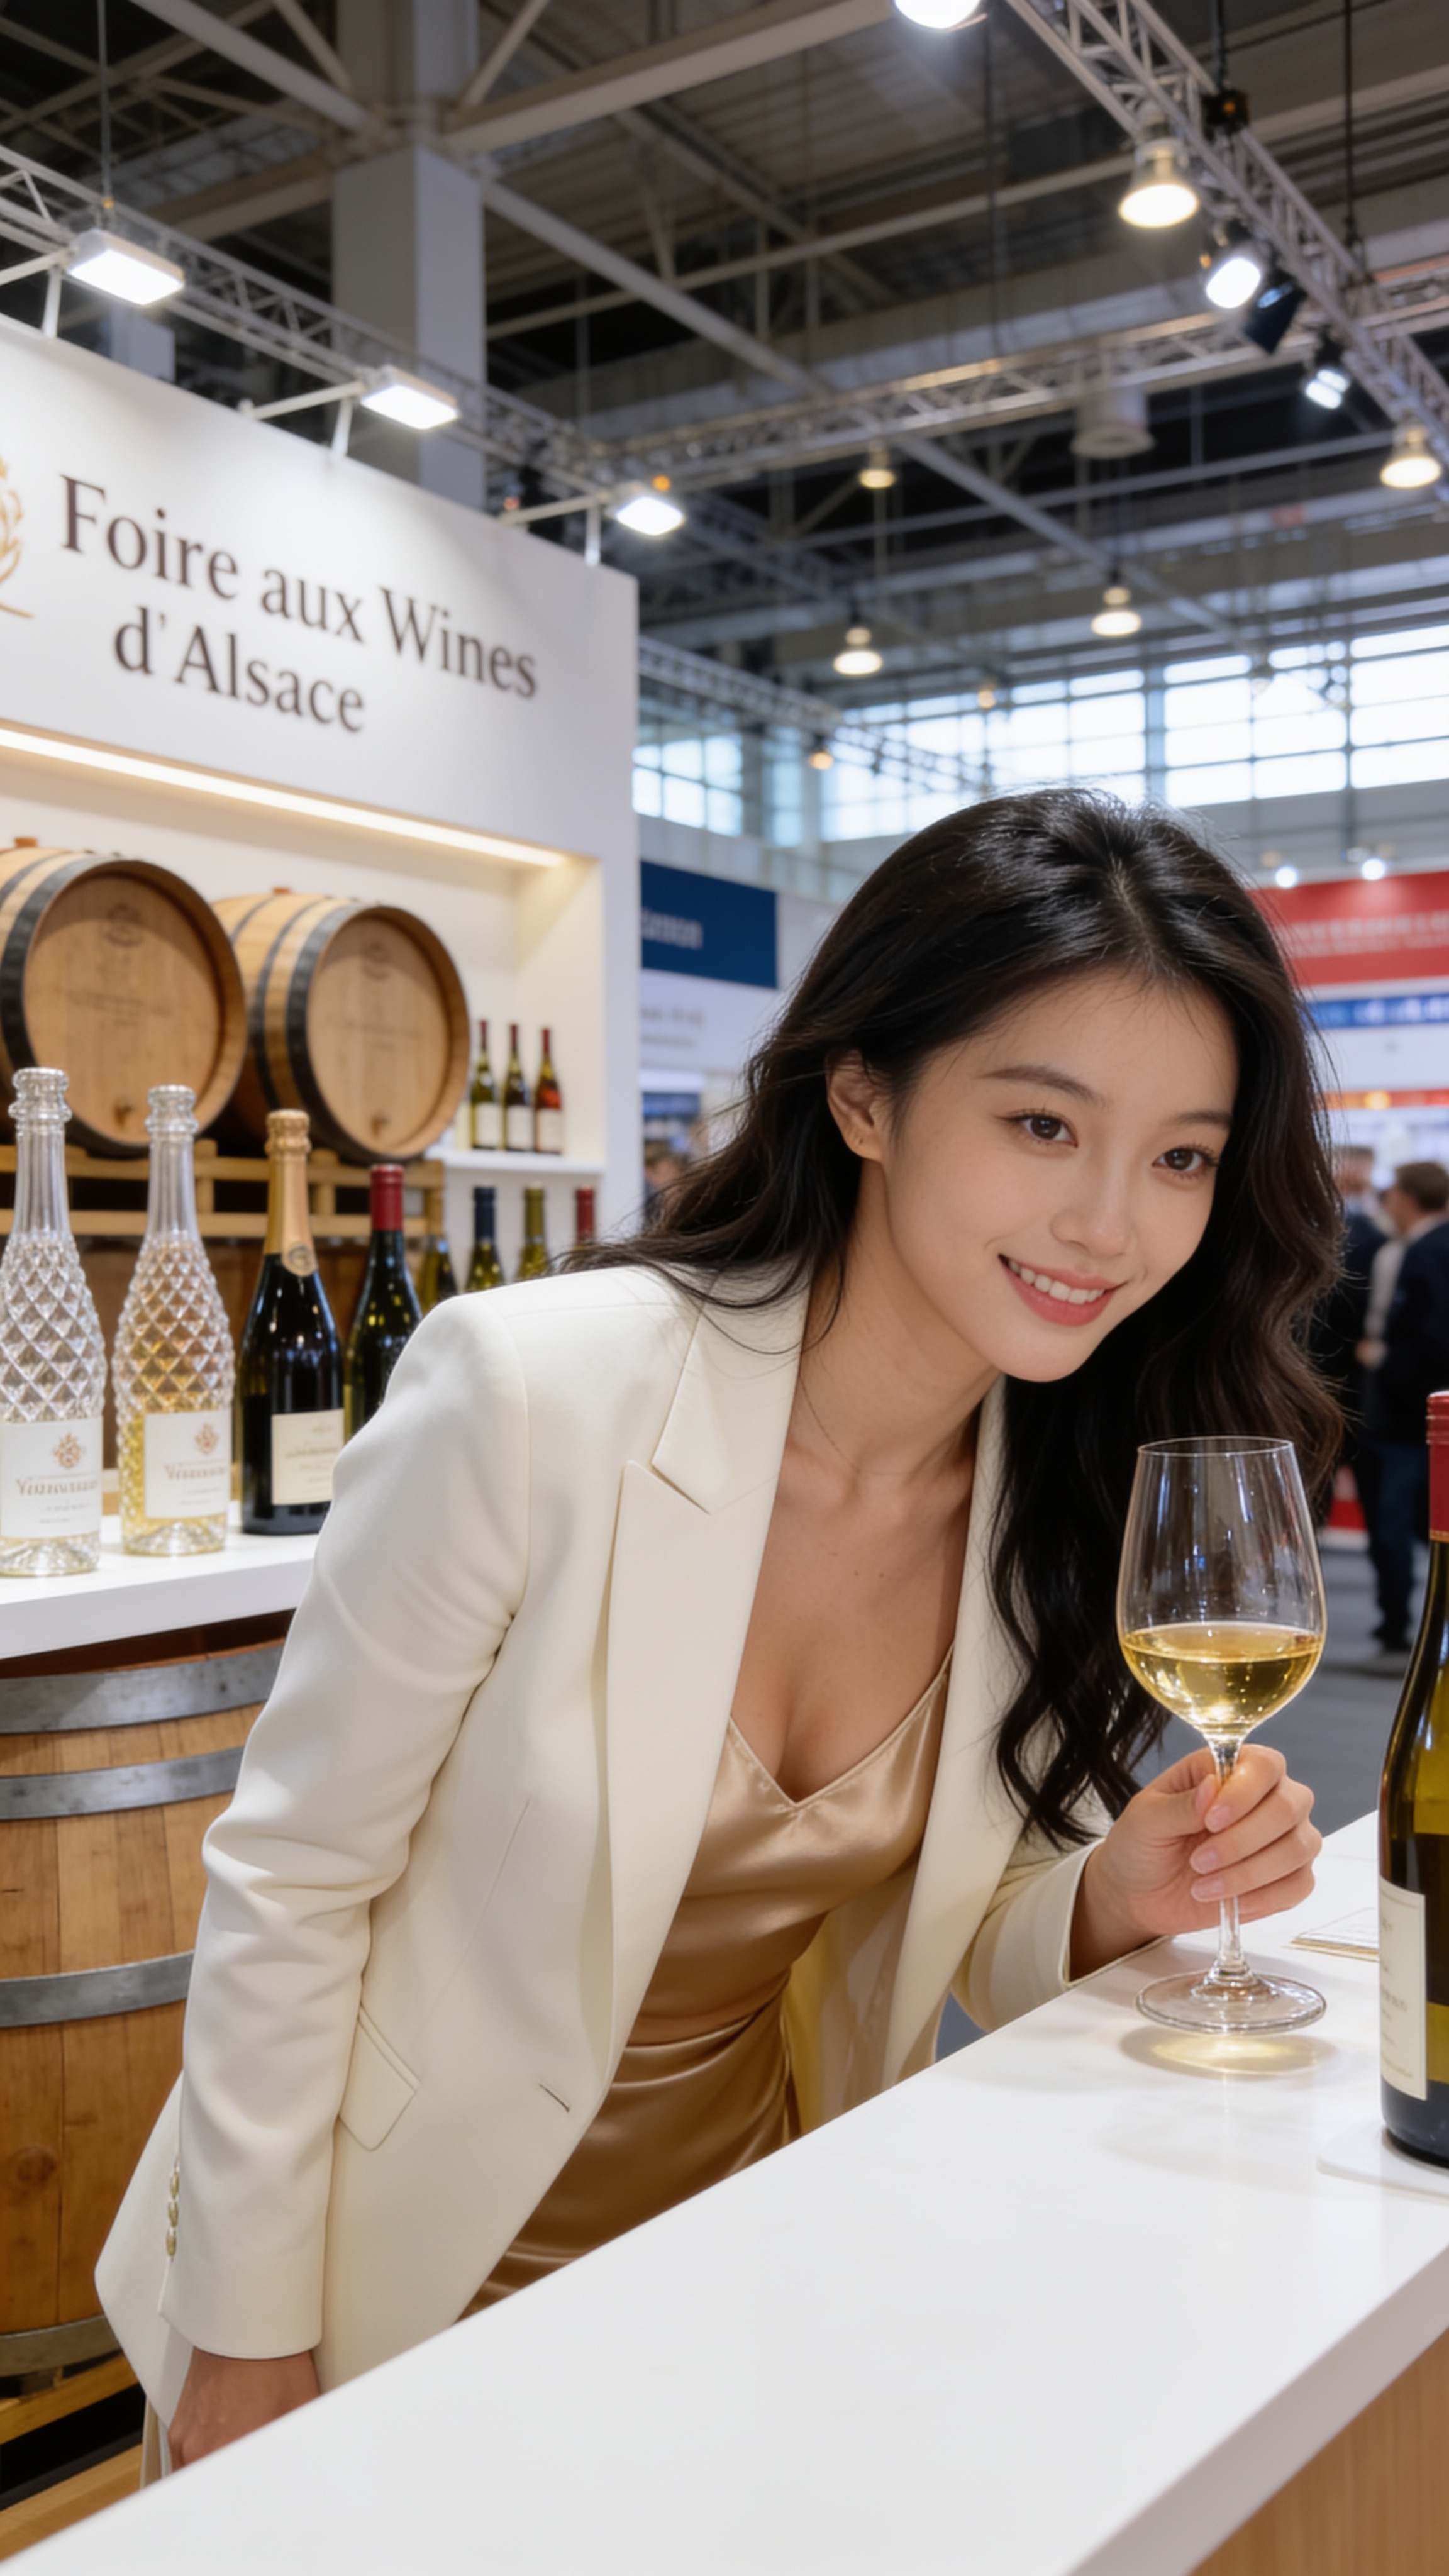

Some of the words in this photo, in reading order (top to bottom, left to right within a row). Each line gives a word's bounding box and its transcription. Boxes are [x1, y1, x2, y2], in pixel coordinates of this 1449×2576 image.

[60, 473, 240, 600] Foire
[260, 567, 369, 645] aux
[377, 585, 539, 701] Wines
